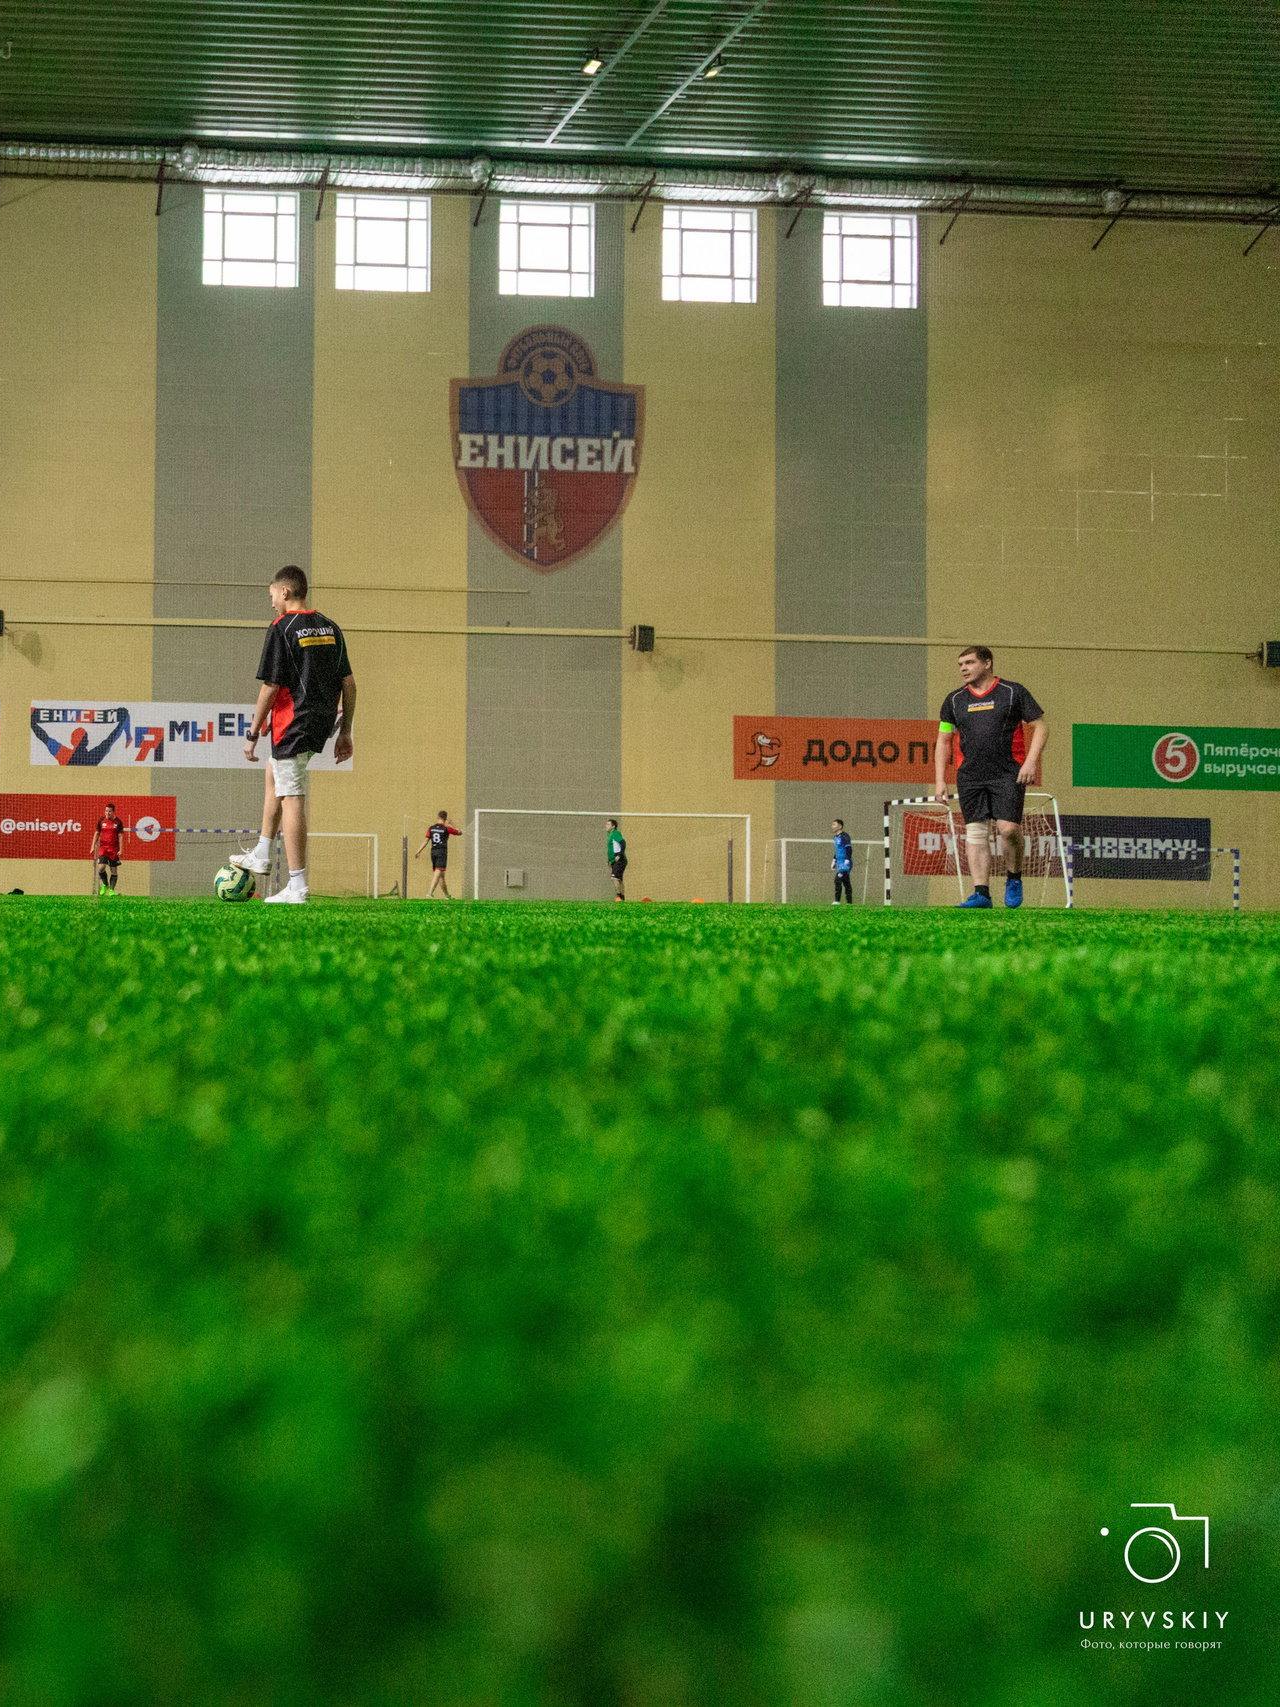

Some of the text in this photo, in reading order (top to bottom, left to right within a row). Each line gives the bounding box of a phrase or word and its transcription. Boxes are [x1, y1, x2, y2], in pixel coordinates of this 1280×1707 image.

[458, 431, 636, 474] ЕНИСЕЙ
[39, 709, 118, 722] ЕНИСЕЙ
[134, 726, 165, 762] Я
[169, 720, 214, 743] МЫ
[802, 739, 900, 768] ДОДО
[1203, 743, 1280, 761] Пятёроч
[1203, 763, 1280, 777] выручае
[0, 818, 82, 835] @eniseyfc
